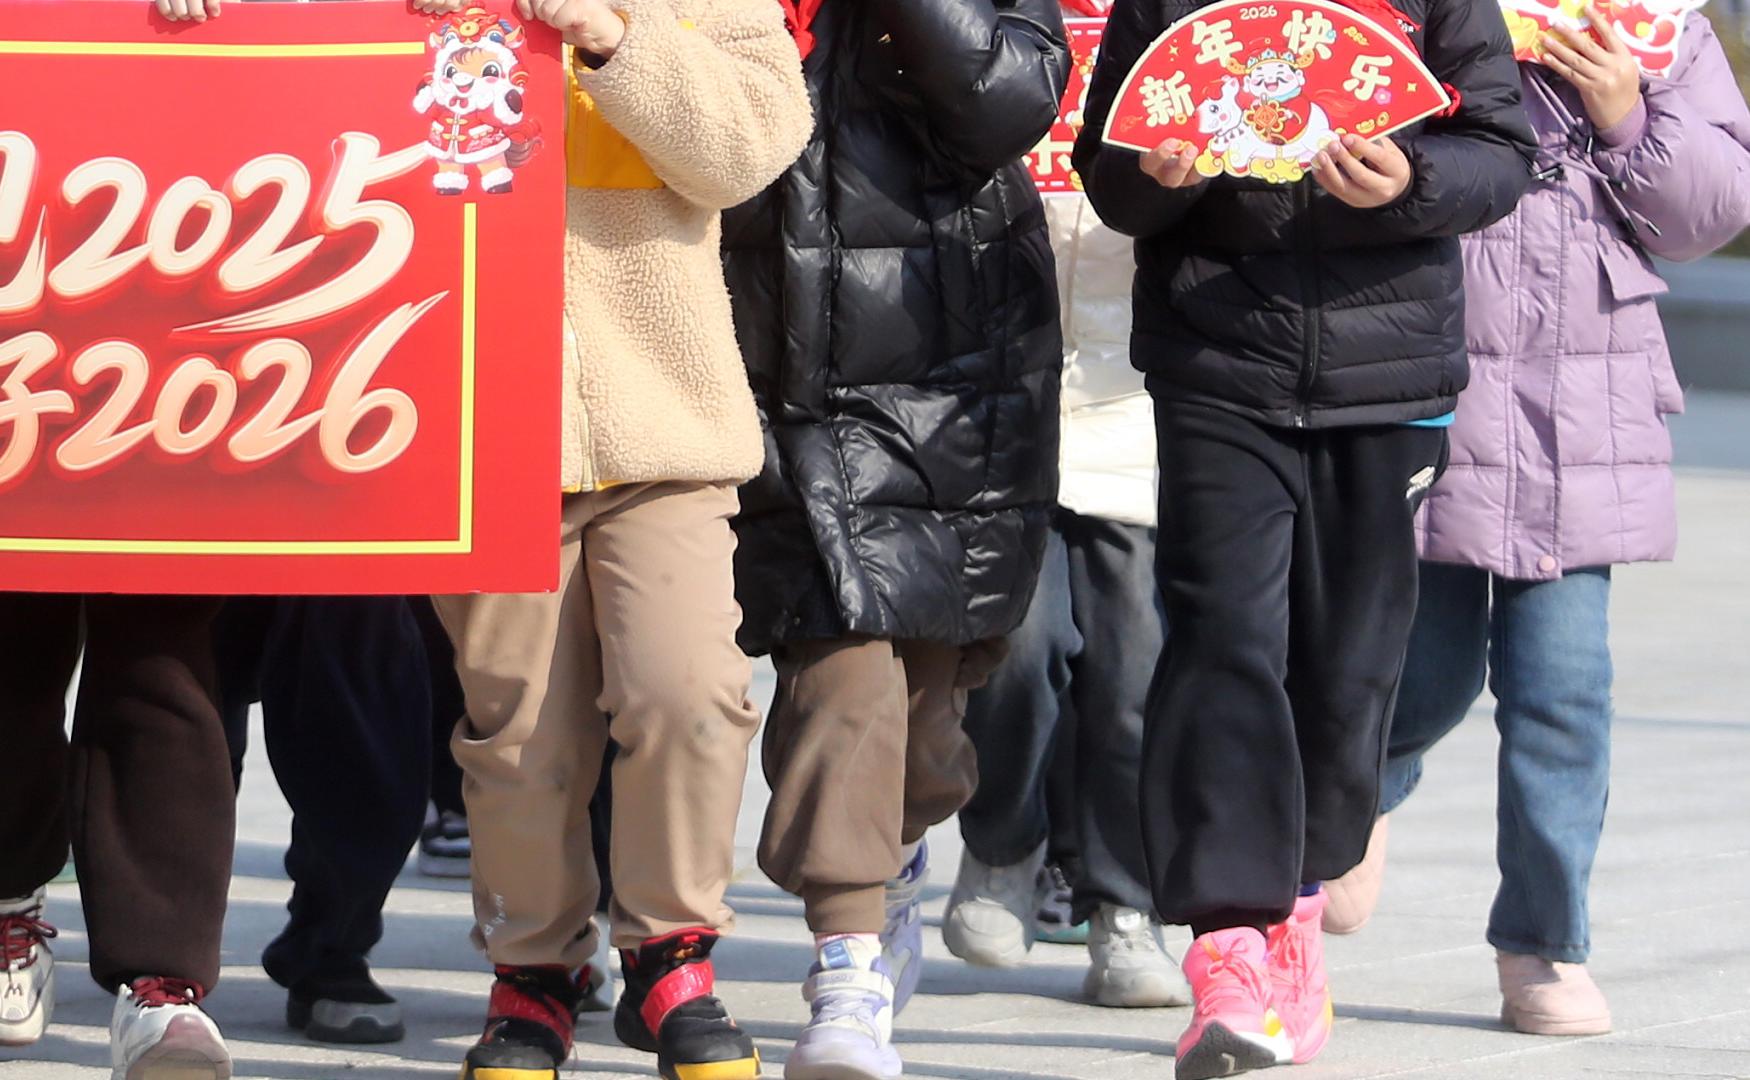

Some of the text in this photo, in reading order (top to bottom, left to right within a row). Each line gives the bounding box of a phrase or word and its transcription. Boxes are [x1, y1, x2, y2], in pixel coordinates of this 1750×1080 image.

[1239, 5, 1278, 20] 2026
[1139, 9, 1394, 128] 新年快乐
